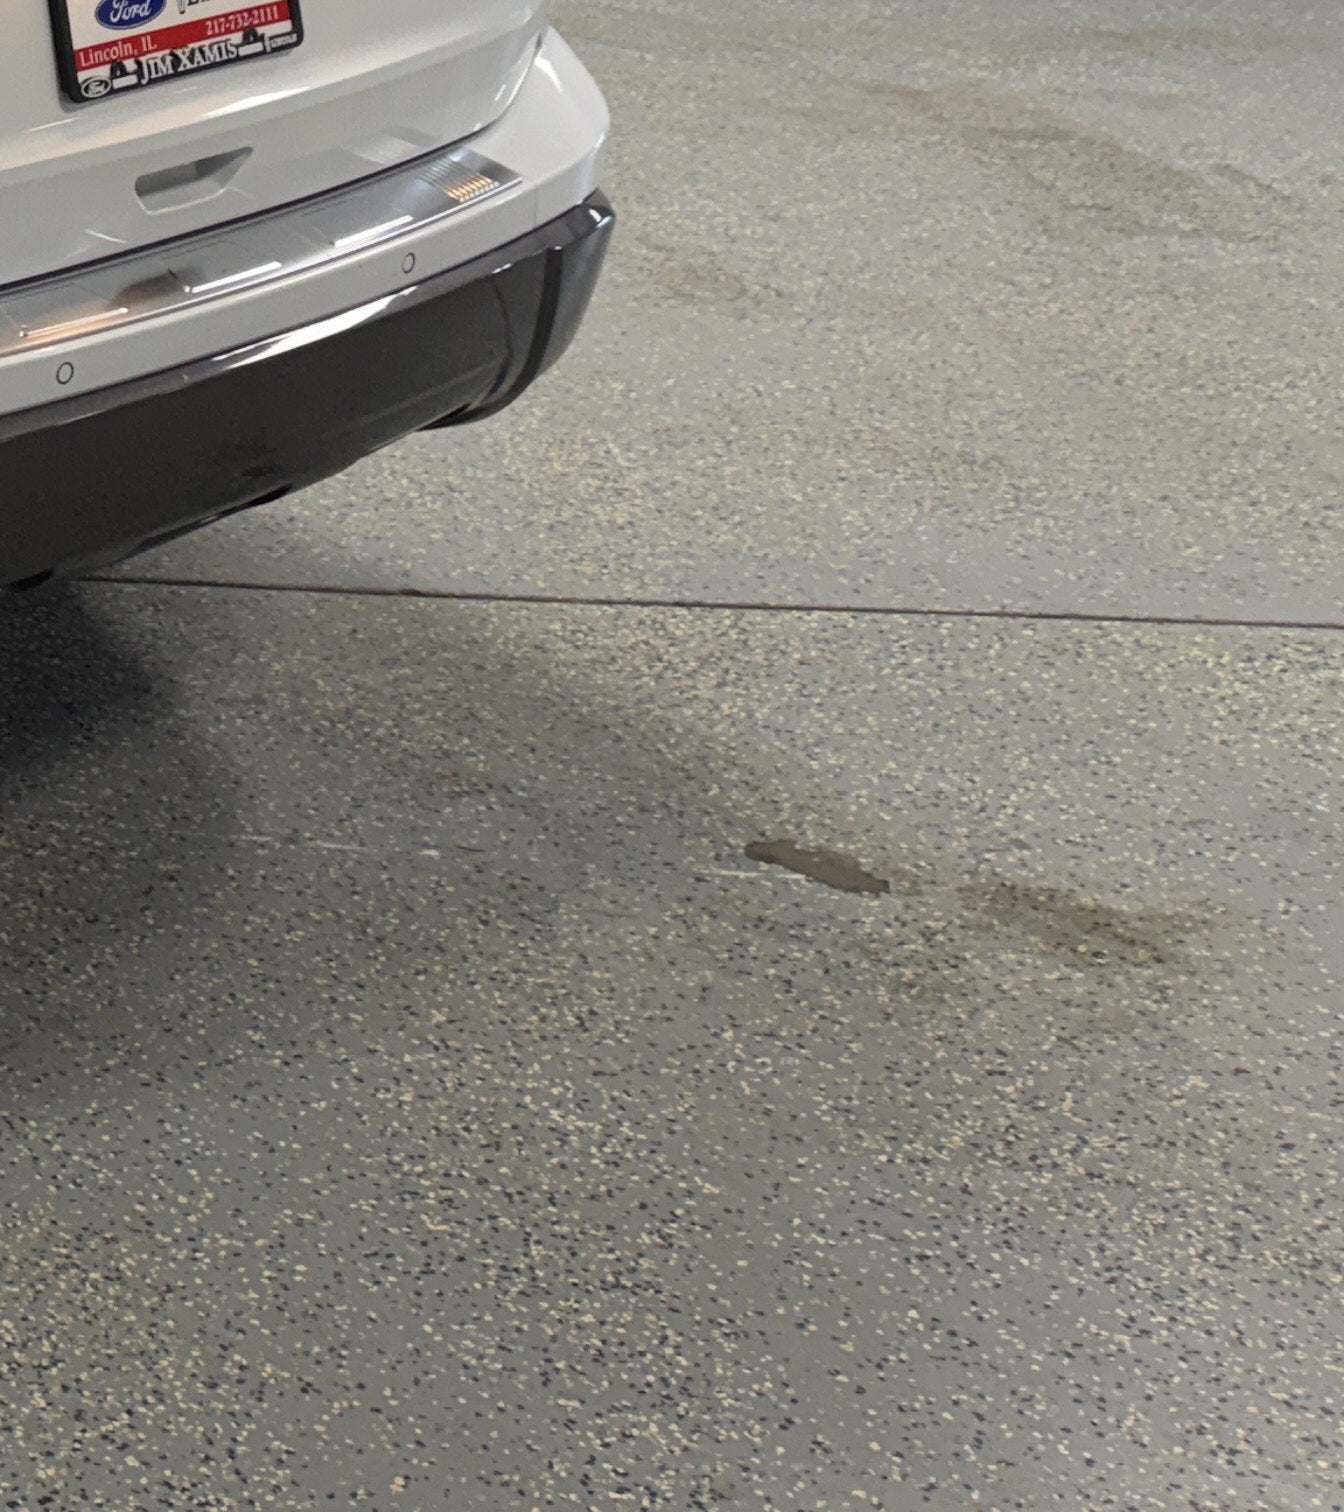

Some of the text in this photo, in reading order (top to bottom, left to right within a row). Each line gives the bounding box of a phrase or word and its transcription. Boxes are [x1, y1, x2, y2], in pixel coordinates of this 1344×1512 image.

[205, 5, 279, 35] 217-732-2111
[79, 35, 158, 67] Lincoln, IL
[140, 57, 176, 85] JIM
[176, 41, 239, 72] XAMIS
